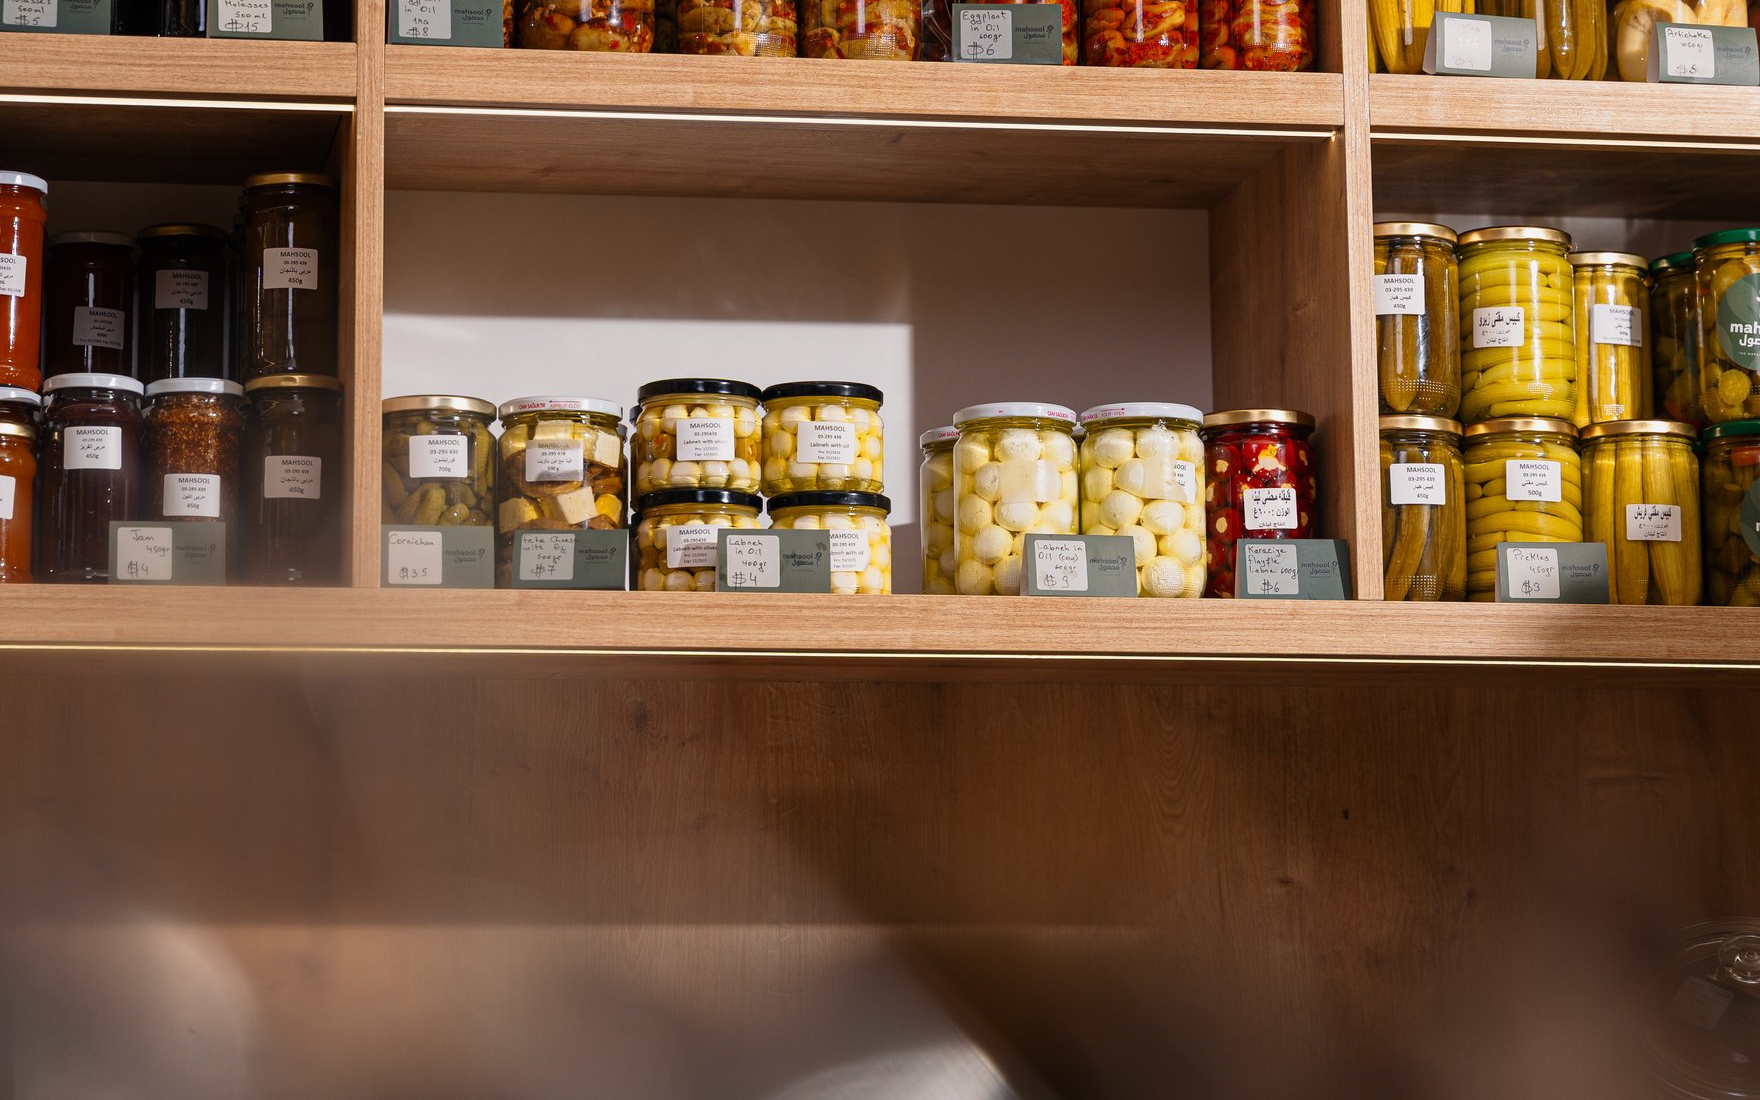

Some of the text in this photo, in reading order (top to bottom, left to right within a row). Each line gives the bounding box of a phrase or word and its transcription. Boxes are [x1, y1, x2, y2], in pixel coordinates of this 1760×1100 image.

[225, 0, 268, 8] Molasses
[419, 6, 435, 14] Oil
[962, 10, 1007, 25] Eggplant
[985, 24, 1000, 32] Oil
[88, 310, 118, 319] MAHSOOL
[130, 529, 155, 542] Jam
[679, 528, 711, 536] MAHSOOL
[729, 538, 763, 547] Labneh
[1036, 541, 1069, 552] Labneh
[748, 547, 762, 556] Oil
[782, 552, 814, 560] mahsool
[1038, 552, 1052, 561] Oil
[1089, 557, 1119, 565] mahsool
[1301, 561, 1332, 569] mahsool
